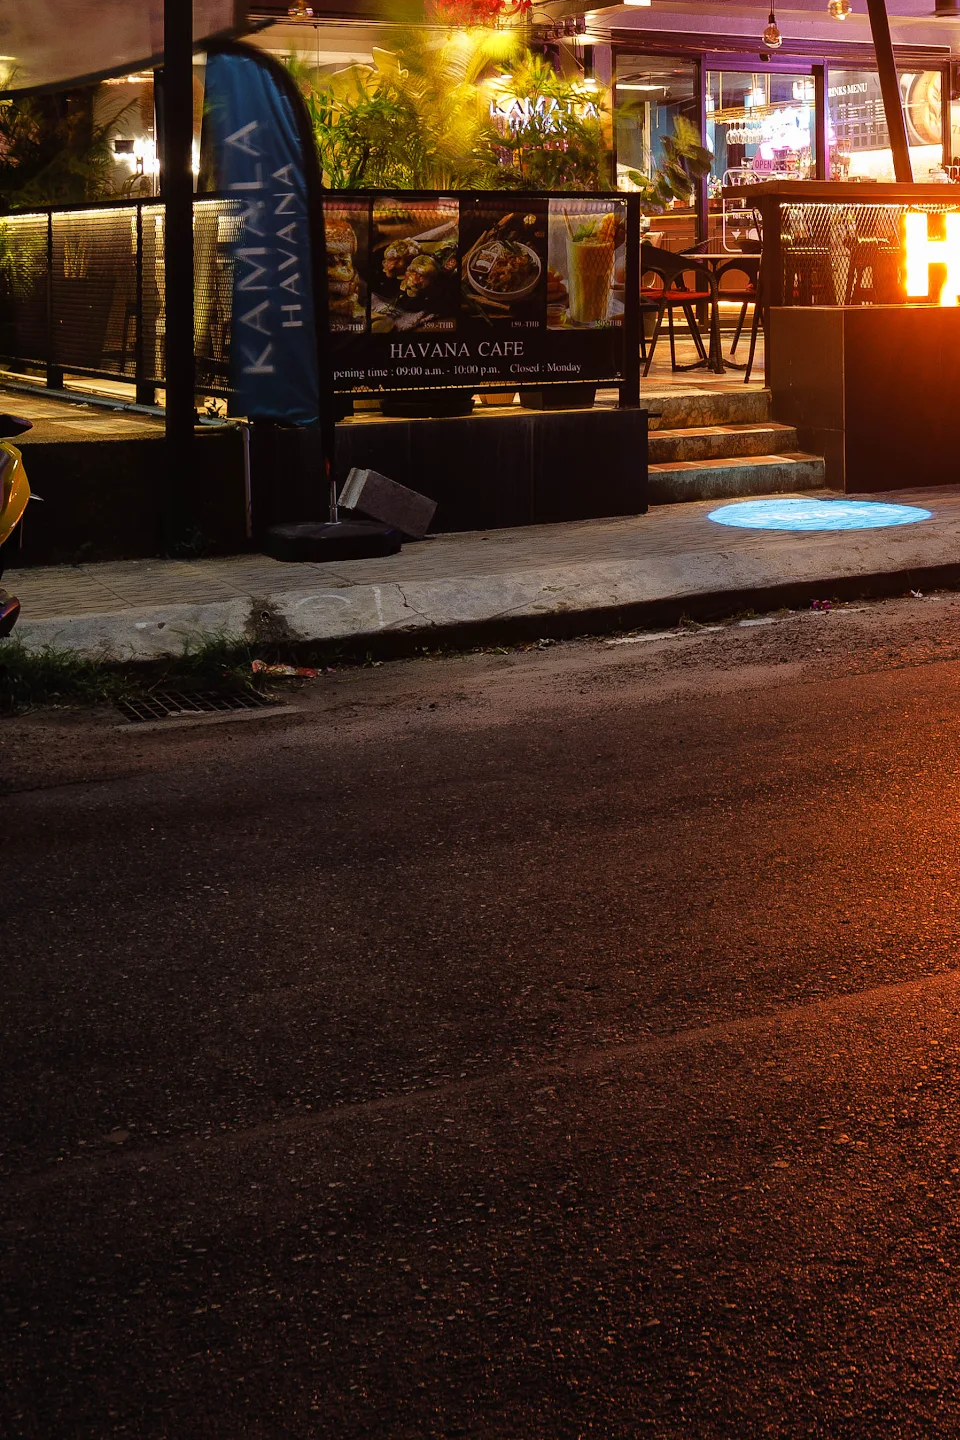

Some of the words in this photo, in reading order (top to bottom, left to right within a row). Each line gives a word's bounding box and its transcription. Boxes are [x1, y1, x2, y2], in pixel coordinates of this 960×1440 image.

[828, 86, 846, 98] RINKS
[847, 82, 868, 95] MENU
[755, 160, 772, 169] OPEN
[224, 120, 275, 375] KAMALA
[271, 163, 303, 328] HAVANA
[390, 343, 471, 359] HAVANA
[478, 341, 525, 357] CAFE
[333, 368, 365, 380] pening
[368, 367, 388, 377] time
[396, 366, 422, 376] 09:00
[454, 365, 479, 375] 10:00
[481, 367, 500, 376] p.m.
[510, 363, 540, 373] Closed
[547, 362, 581, 373] Monday
